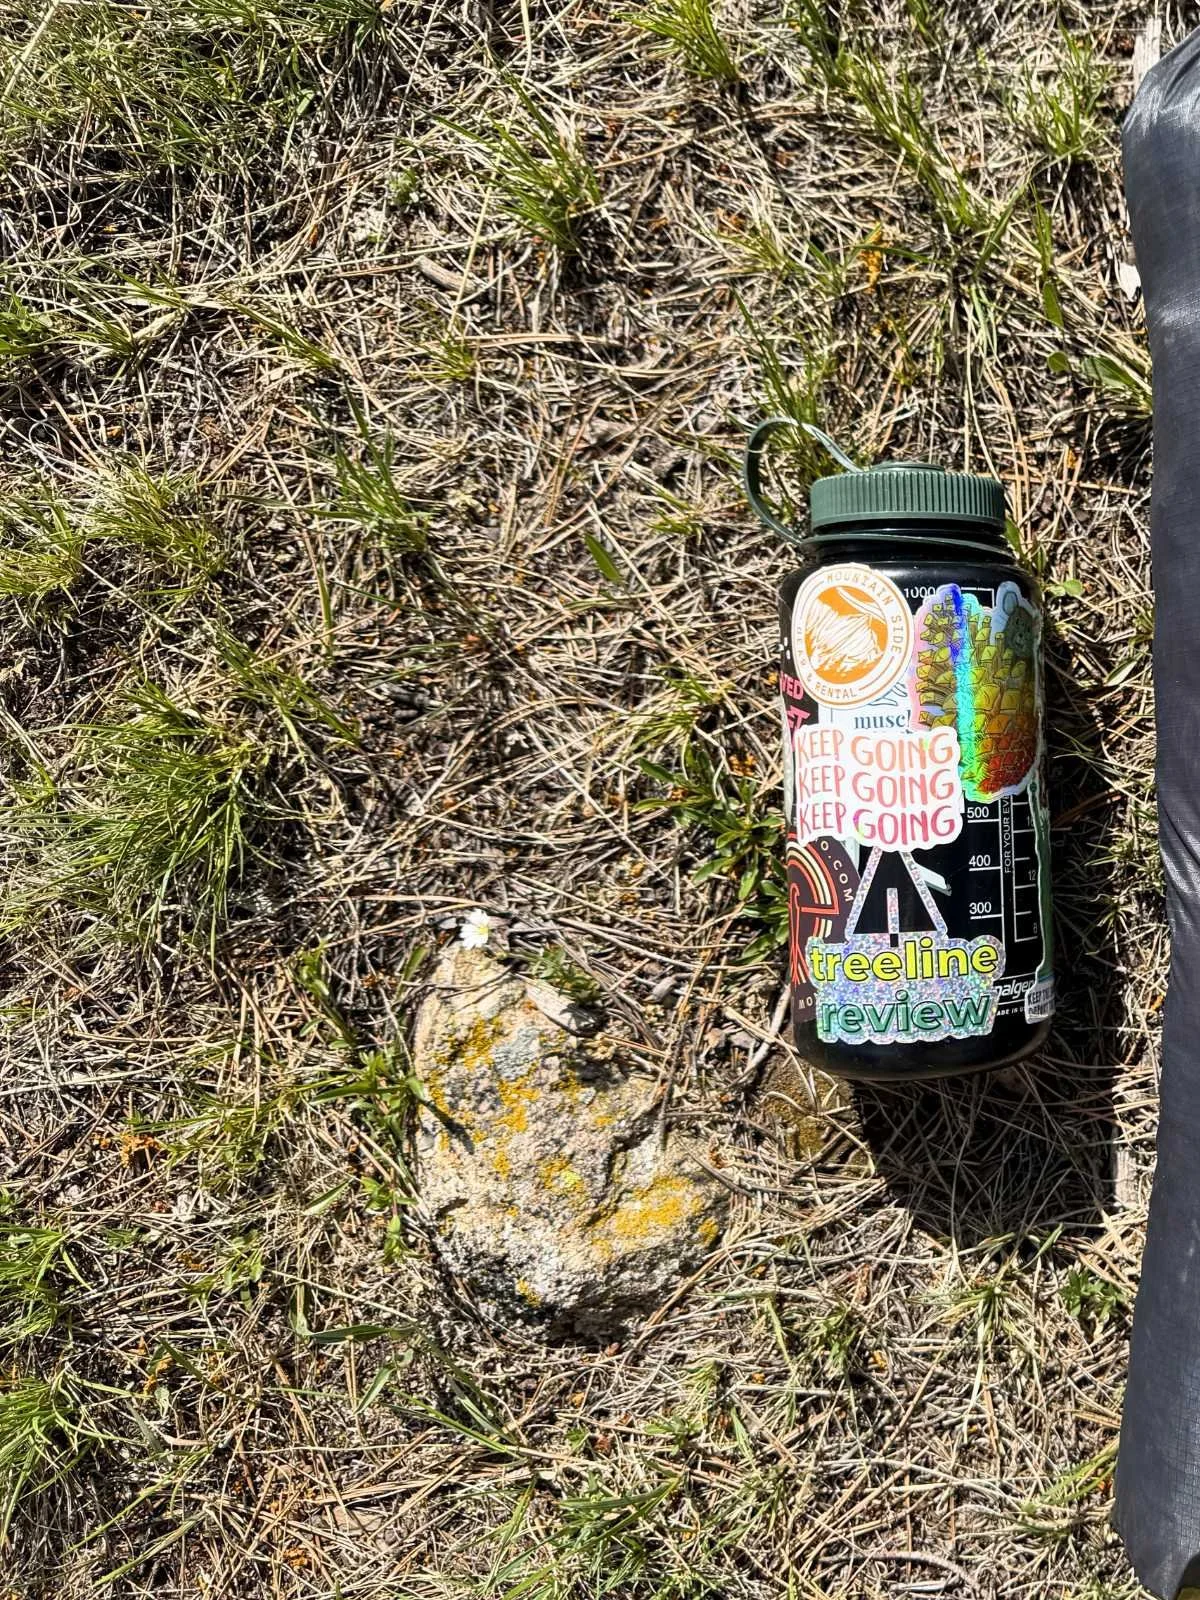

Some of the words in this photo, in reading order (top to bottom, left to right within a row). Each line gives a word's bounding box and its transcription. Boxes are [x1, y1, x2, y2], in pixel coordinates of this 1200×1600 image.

[903, 586, 937, 599] 1000
[826, 571, 894, 607] MOUNTAIN
[891, 615, 904, 654] SIDE
[814, 681, 859, 699] RENTAL
[798, 729, 844, 763] KEEP
[851, 732, 955, 772] GOING
[799, 765, 847, 802] KEEP
[851, 769, 955, 808] GOING
[799, 802, 847, 840] KEEP
[853, 806, 955, 845] GOING
[967, 806, 990, 818] 500
[1003, 817, 1011, 848] YOUR
[968, 854, 991, 867] 400
[1004, 850, 1012, 874] FOR
[1028, 869, 1037, 881] 12
[969, 901, 992, 914] 300
[809, 937, 998, 983] treeline
[820, 989, 991, 1034] review
